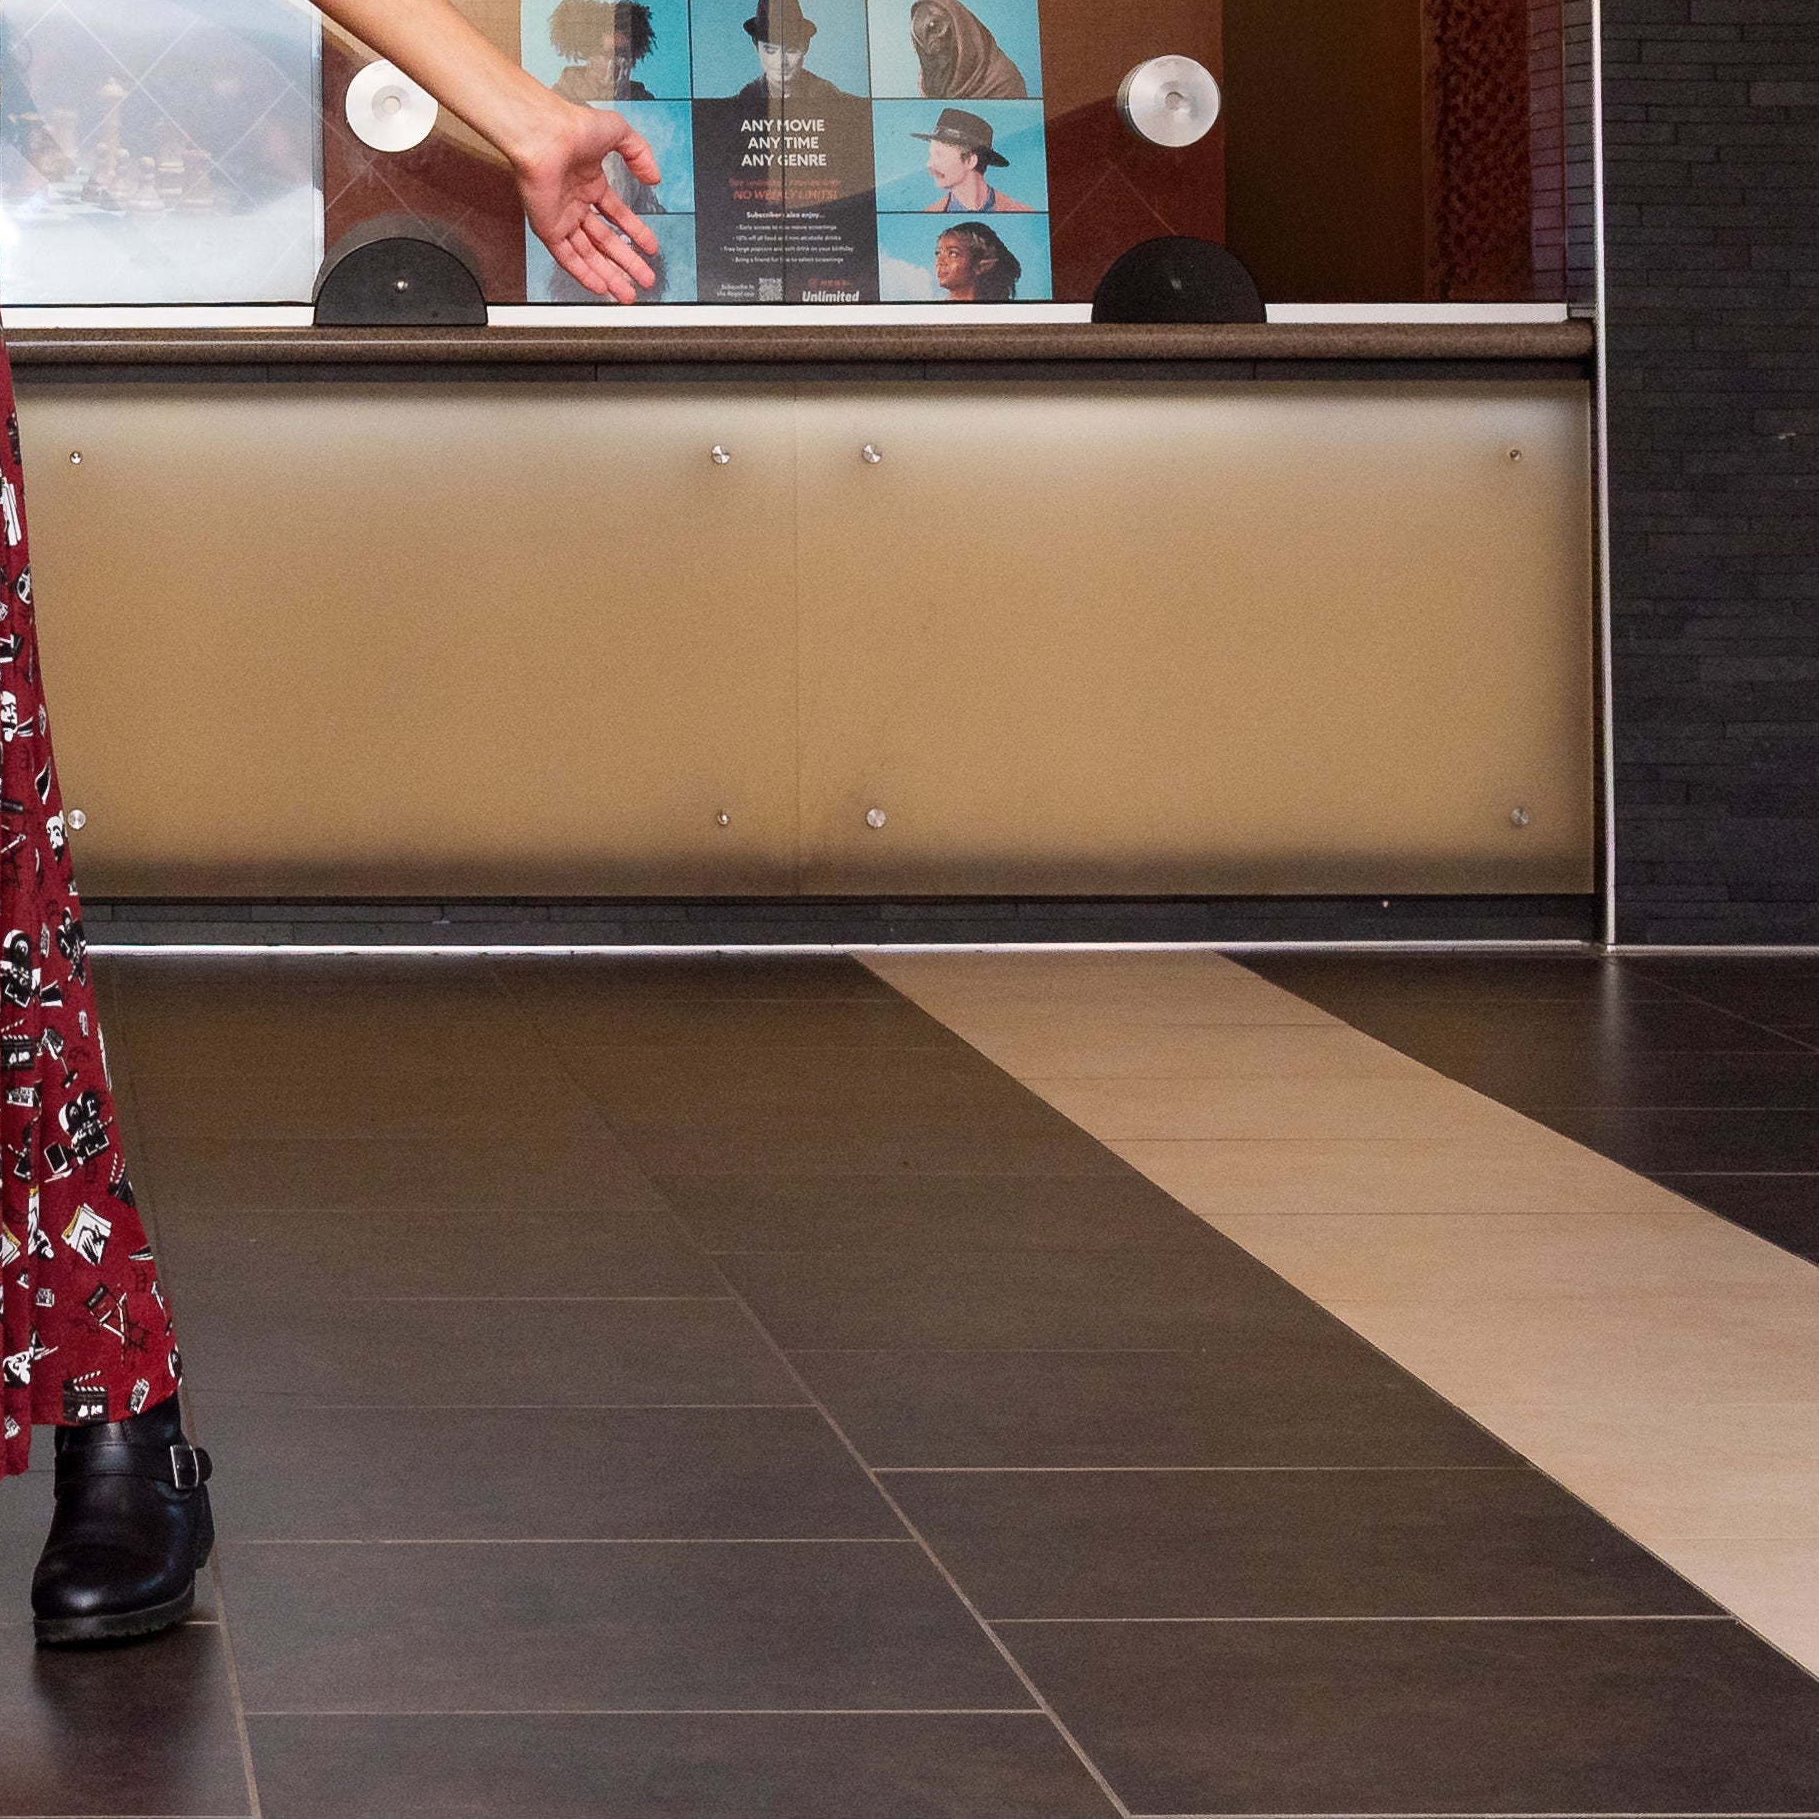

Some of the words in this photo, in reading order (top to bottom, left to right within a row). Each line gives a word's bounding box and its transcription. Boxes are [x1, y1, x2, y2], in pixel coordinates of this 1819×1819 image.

[740, 119, 775, 132] ANY
[777, 119, 825, 132] MOVIE
[747, 136, 783, 149] ANY
[784, 136, 820, 149] TIME
[740, 154, 775, 167] ANY
[777, 154, 828, 167] GENRE
[733, 189, 753, 200] NO
[746, 211, 785, 219] Subscriber
[802, 290, 861, 303] Unlimited
